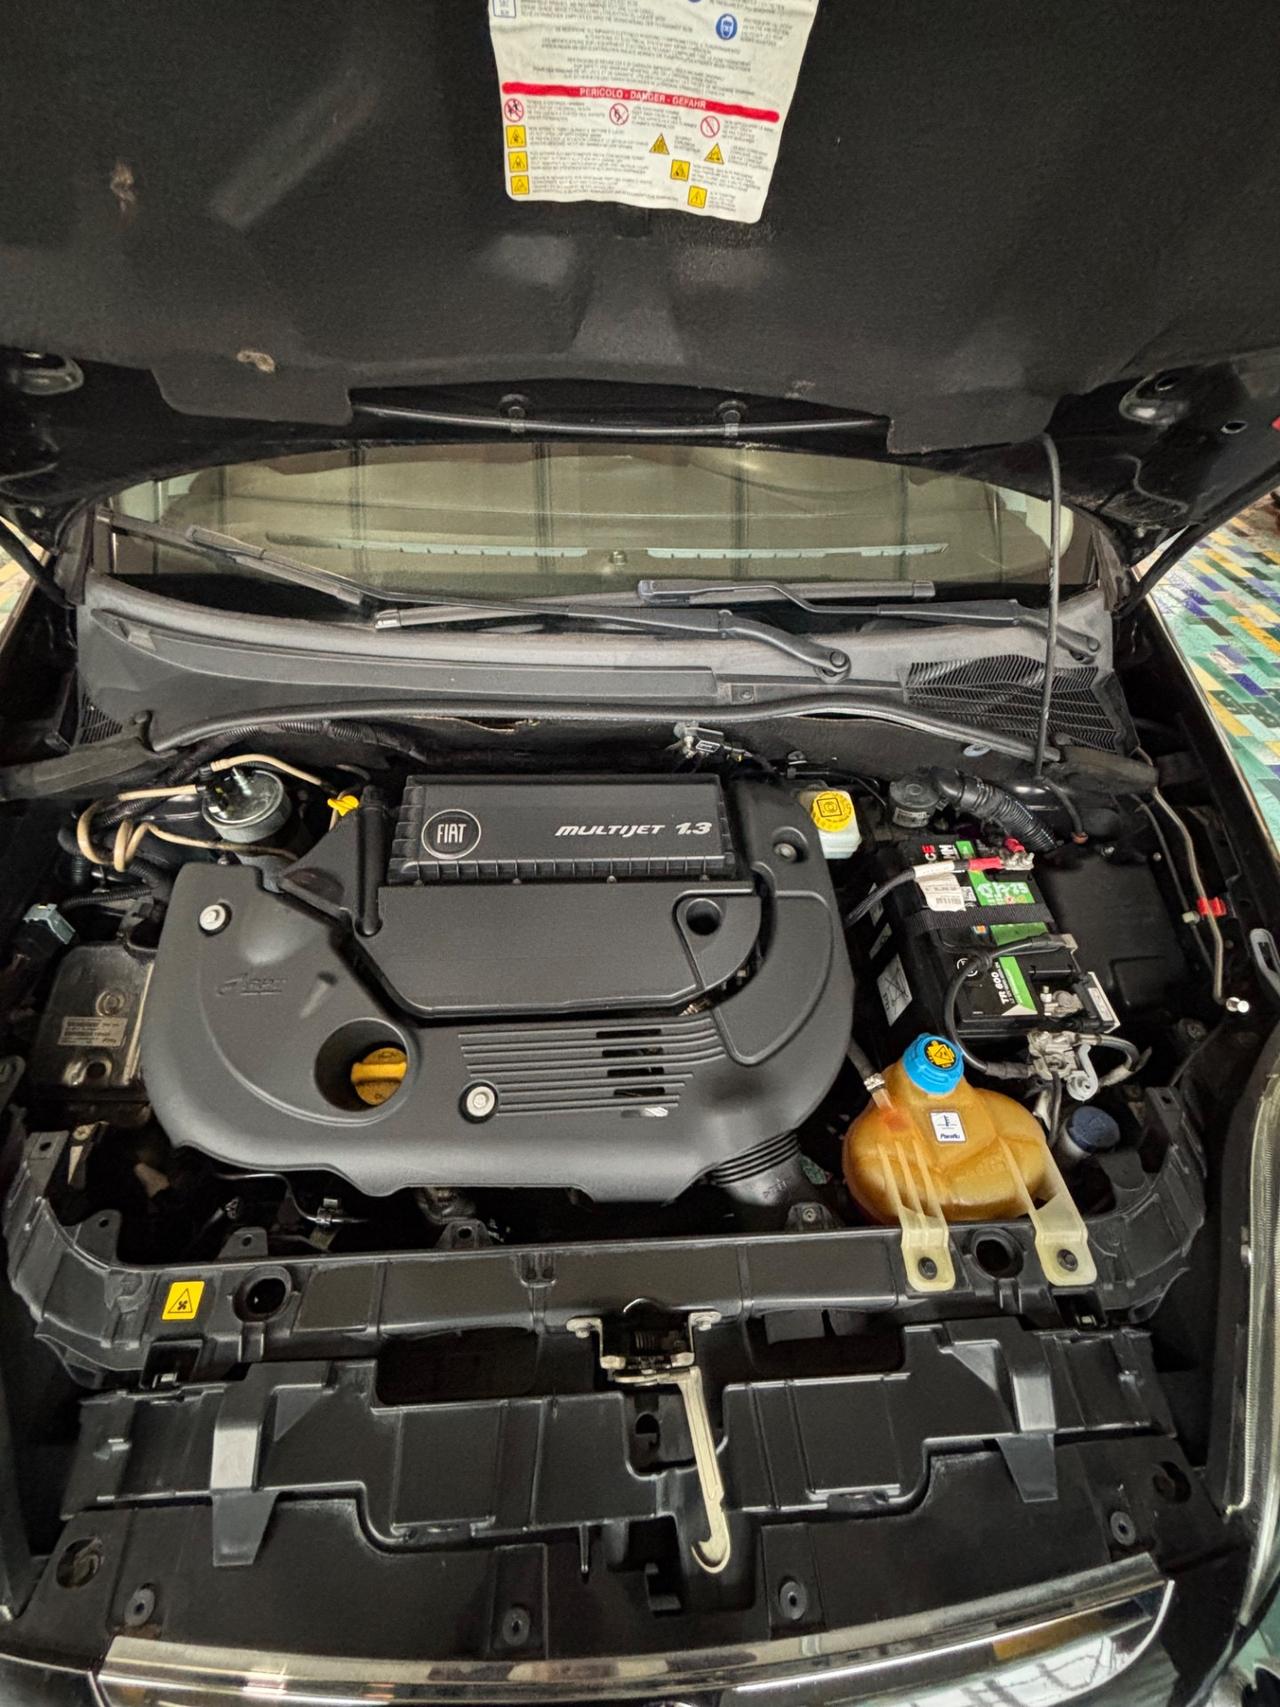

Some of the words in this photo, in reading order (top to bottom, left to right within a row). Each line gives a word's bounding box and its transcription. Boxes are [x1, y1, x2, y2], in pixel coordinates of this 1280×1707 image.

[579, 87, 624, 99] PERICOLO
[630, 90, 666, 103] DANGER
[672, 95, 707, 109] GEFAHR
[437, 823, 467, 844] FIAT
[554, 824, 666, 838] MULTIJET
[675, 822, 712, 835] 1.3
